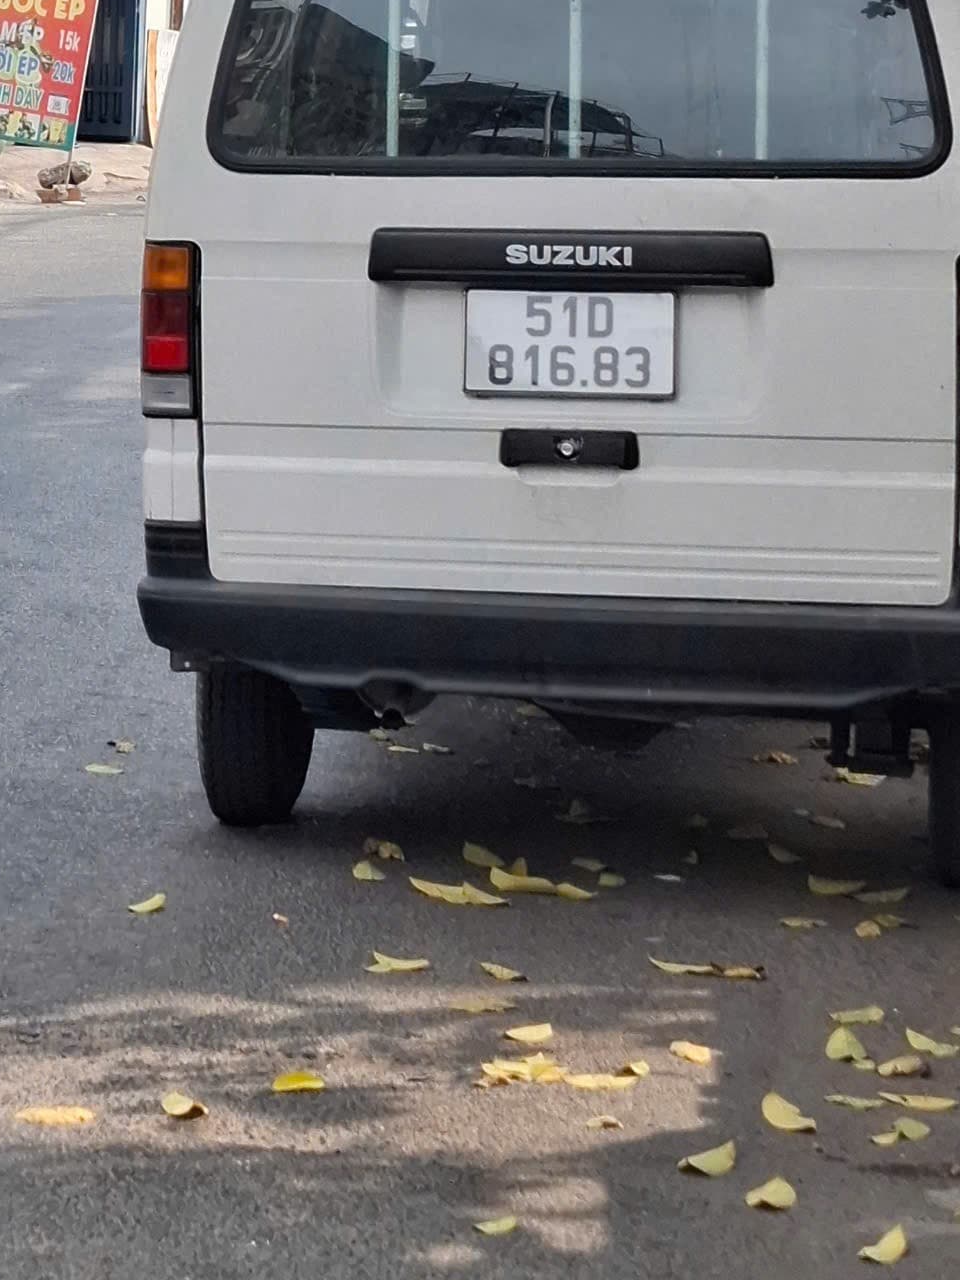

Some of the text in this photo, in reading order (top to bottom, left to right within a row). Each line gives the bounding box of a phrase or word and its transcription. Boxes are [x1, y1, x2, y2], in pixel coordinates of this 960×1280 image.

[17, 51, 39, 77] ÉP
[504, 244, 633, 267] SUZUKI
[525, 295, 614, 338] 51D
[487, 344, 651, 388] 816.83
